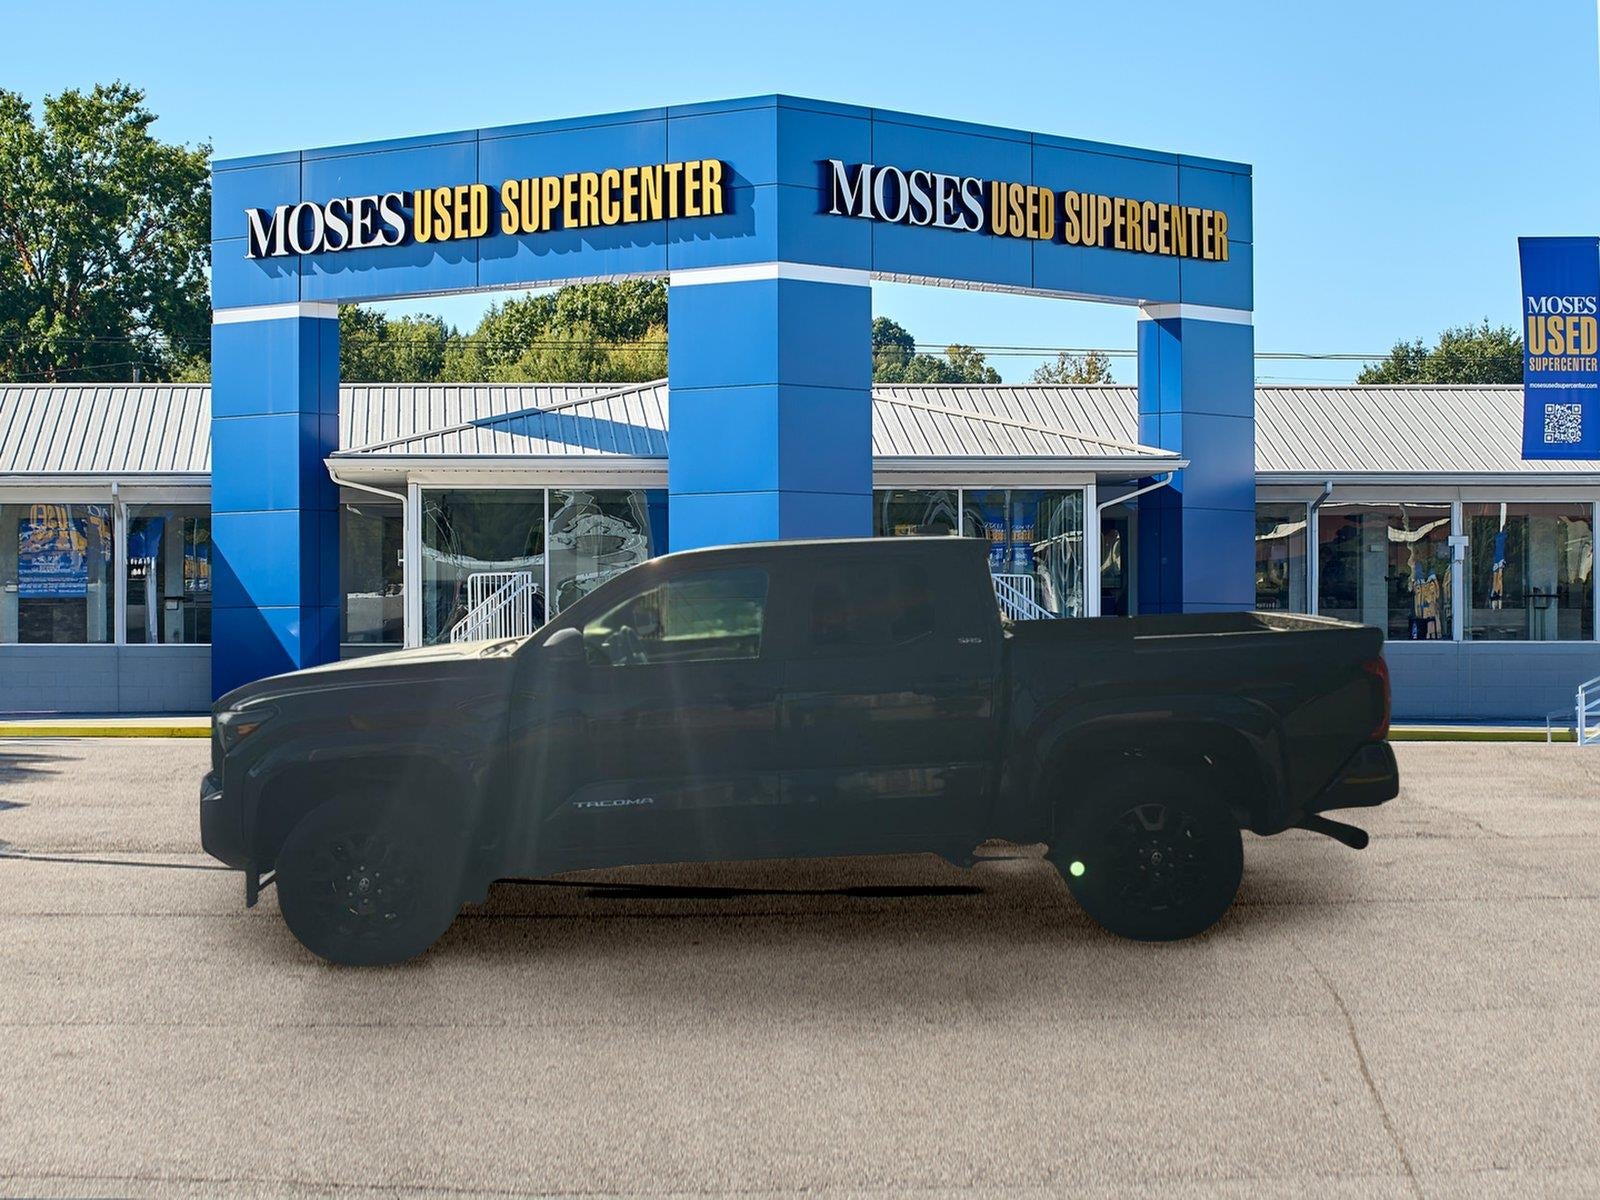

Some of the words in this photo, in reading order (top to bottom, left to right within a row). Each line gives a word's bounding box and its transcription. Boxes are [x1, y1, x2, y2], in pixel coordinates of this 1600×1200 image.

[244, 192, 406, 259] MOSES
[412, 184, 489, 243] USED
[500, 159, 724, 235] SUPERCENTER
[829, 159, 985, 233] MOSES
[991, 181, 1055, 240] USED
[1064, 190, 1229, 261] SUPERCENTER
[1528, 296, 1597, 314] MOSES
[1528, 316, 1598, 355] USED
[1529, 357, 1597, 371] SUPERCENTER
[573, 797, 653, 808] TACOMA
